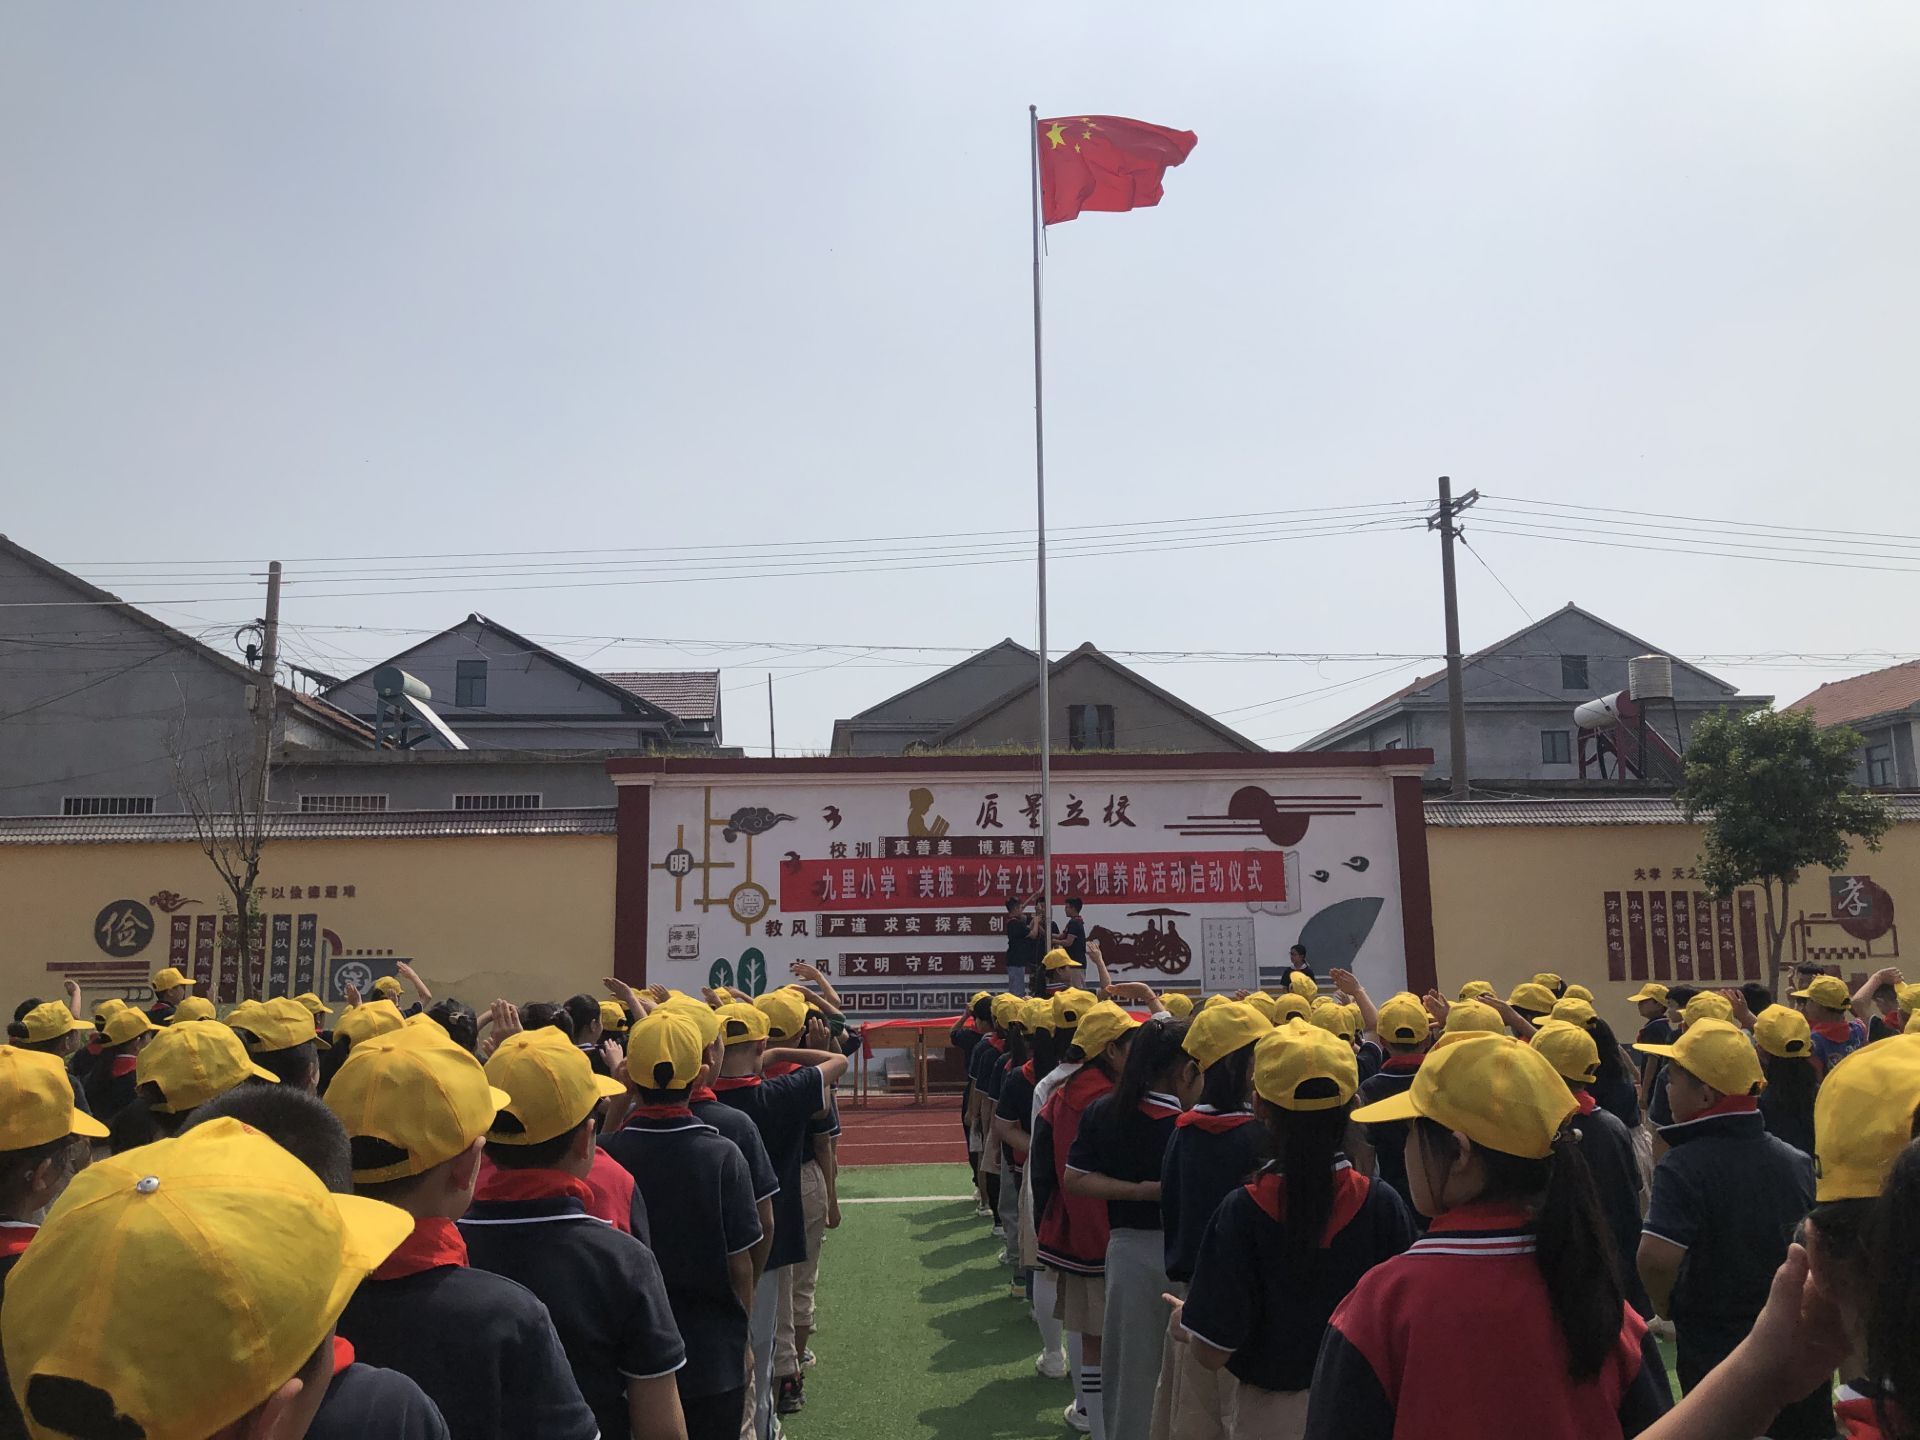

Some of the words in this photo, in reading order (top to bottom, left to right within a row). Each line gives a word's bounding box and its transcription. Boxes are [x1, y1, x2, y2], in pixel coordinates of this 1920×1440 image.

[976, 793, 1136, 829] 质量立校
[830, 842, 872, 858] 校训
[894, 839, 953, 856] 真善美
[977, 839, 1036, 856] 博雅智
[670, 854, 689, 873] 明
[1838, 877, 1868, 916] 孝
[102, 908, 149, 948] 俭
[765, 919, 809, 937] 教风
[829, 917, 868, 934] 严谨
[884, 916, 921, 933] 求实
[935, 916, 973, 932] 探索
[852, 956, 890, 973] 文明
[906, 955, 943, 972] 守纪
[959, 955, 997, 971] 勤学
